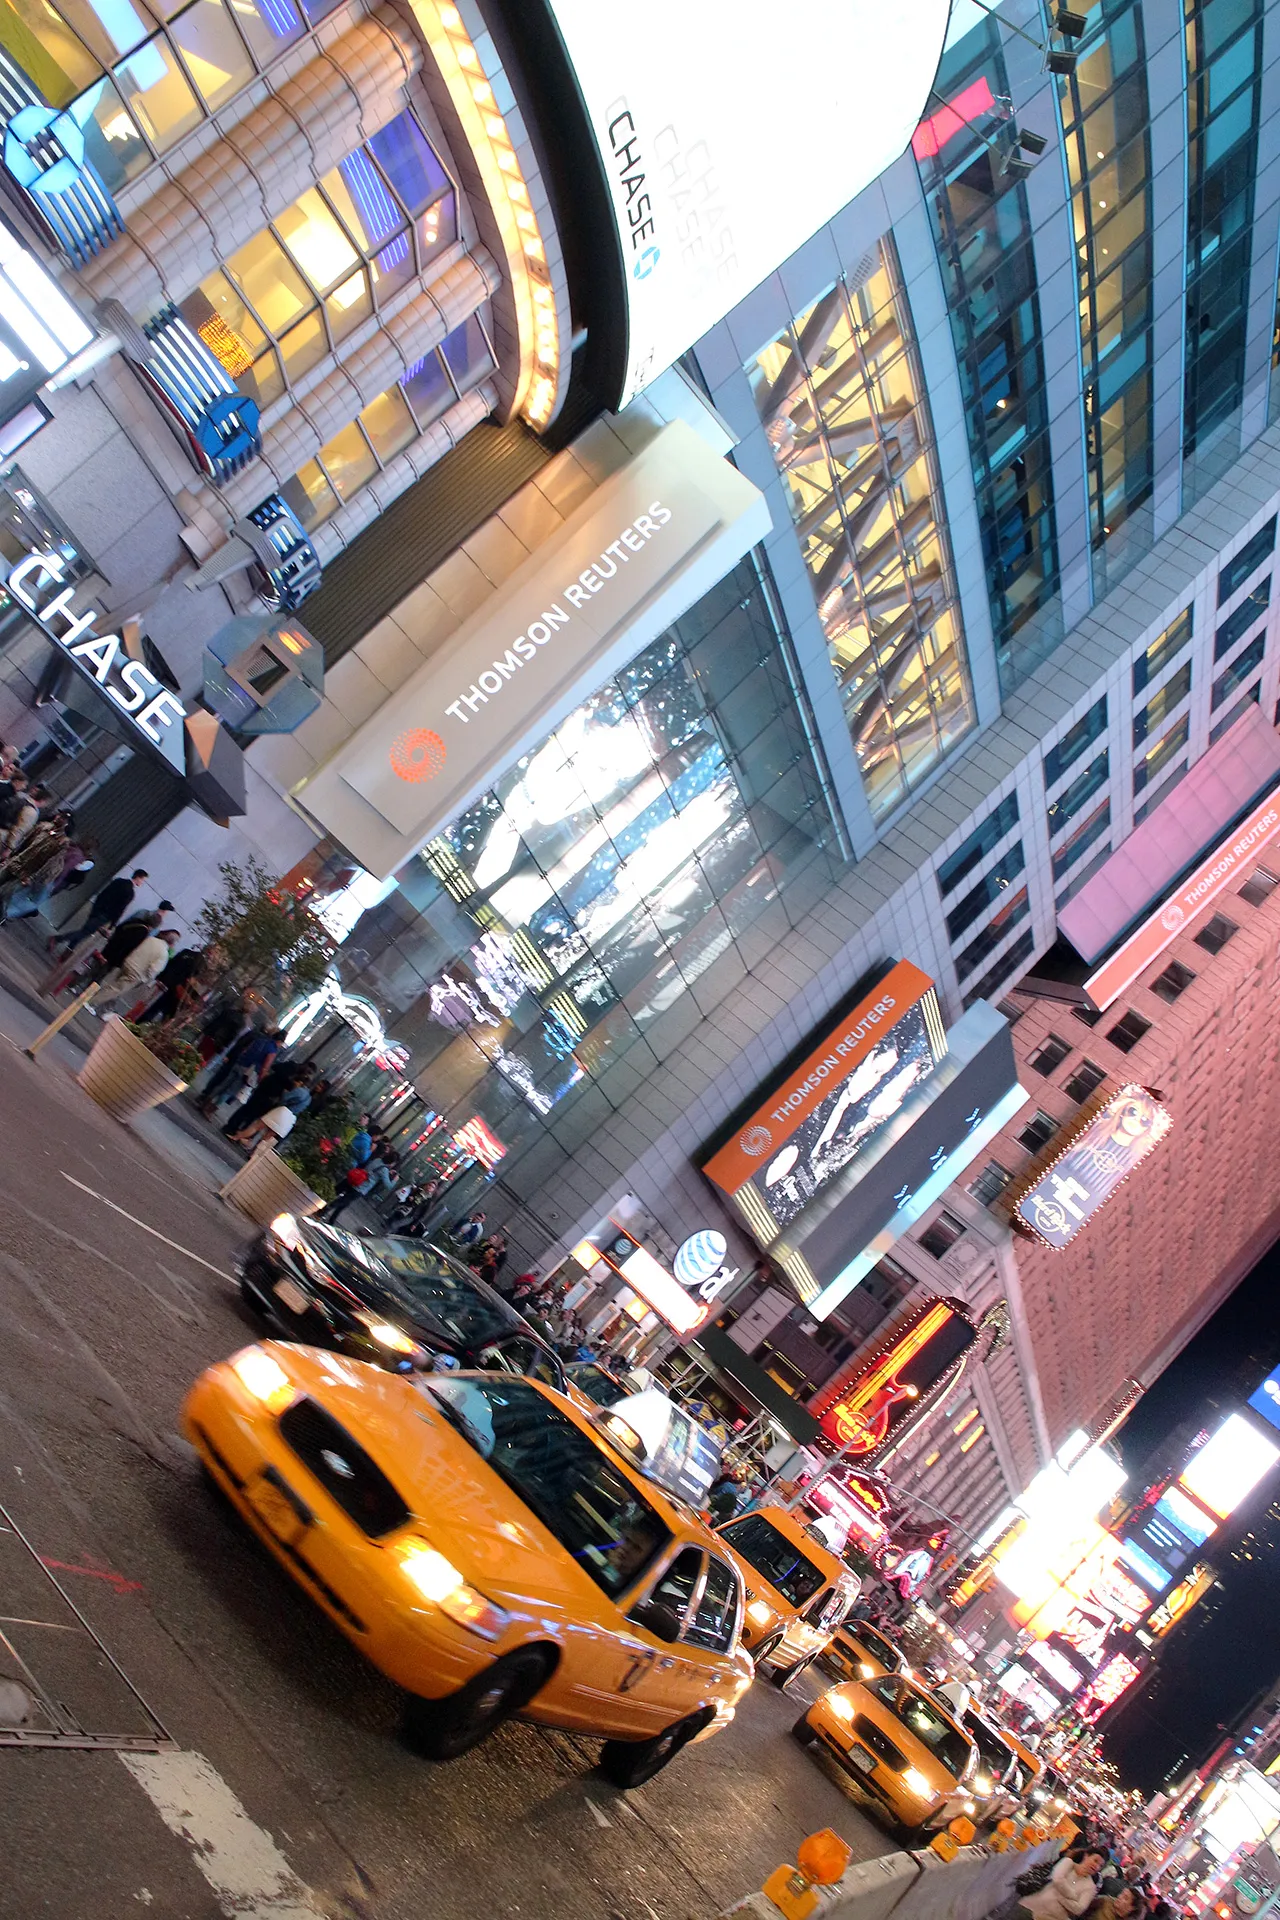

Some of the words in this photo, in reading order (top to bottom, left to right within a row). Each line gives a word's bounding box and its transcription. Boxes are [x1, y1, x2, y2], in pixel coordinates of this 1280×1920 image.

[609, 110, 655, 250] CHASE
[653, 124, 706, 265] CHASE
[684, 138, 739, 283] CHASE
[9, 553, 187, 746] CHASE
[445, 602, 570, 724] THOMSON
[563, 500, 673, 610] REUTERS
[1184, 852, 1236, 906] THOMSON
[1233, 809, 1279, 858] REUTERS
[771, 1053, 841, 1123] THOMSON
[835, 993, 897, 1062] REUTERS
[1030, 1194, 1055, 1216] Hard
[1048, 1212, 1072, 1236] Rock
